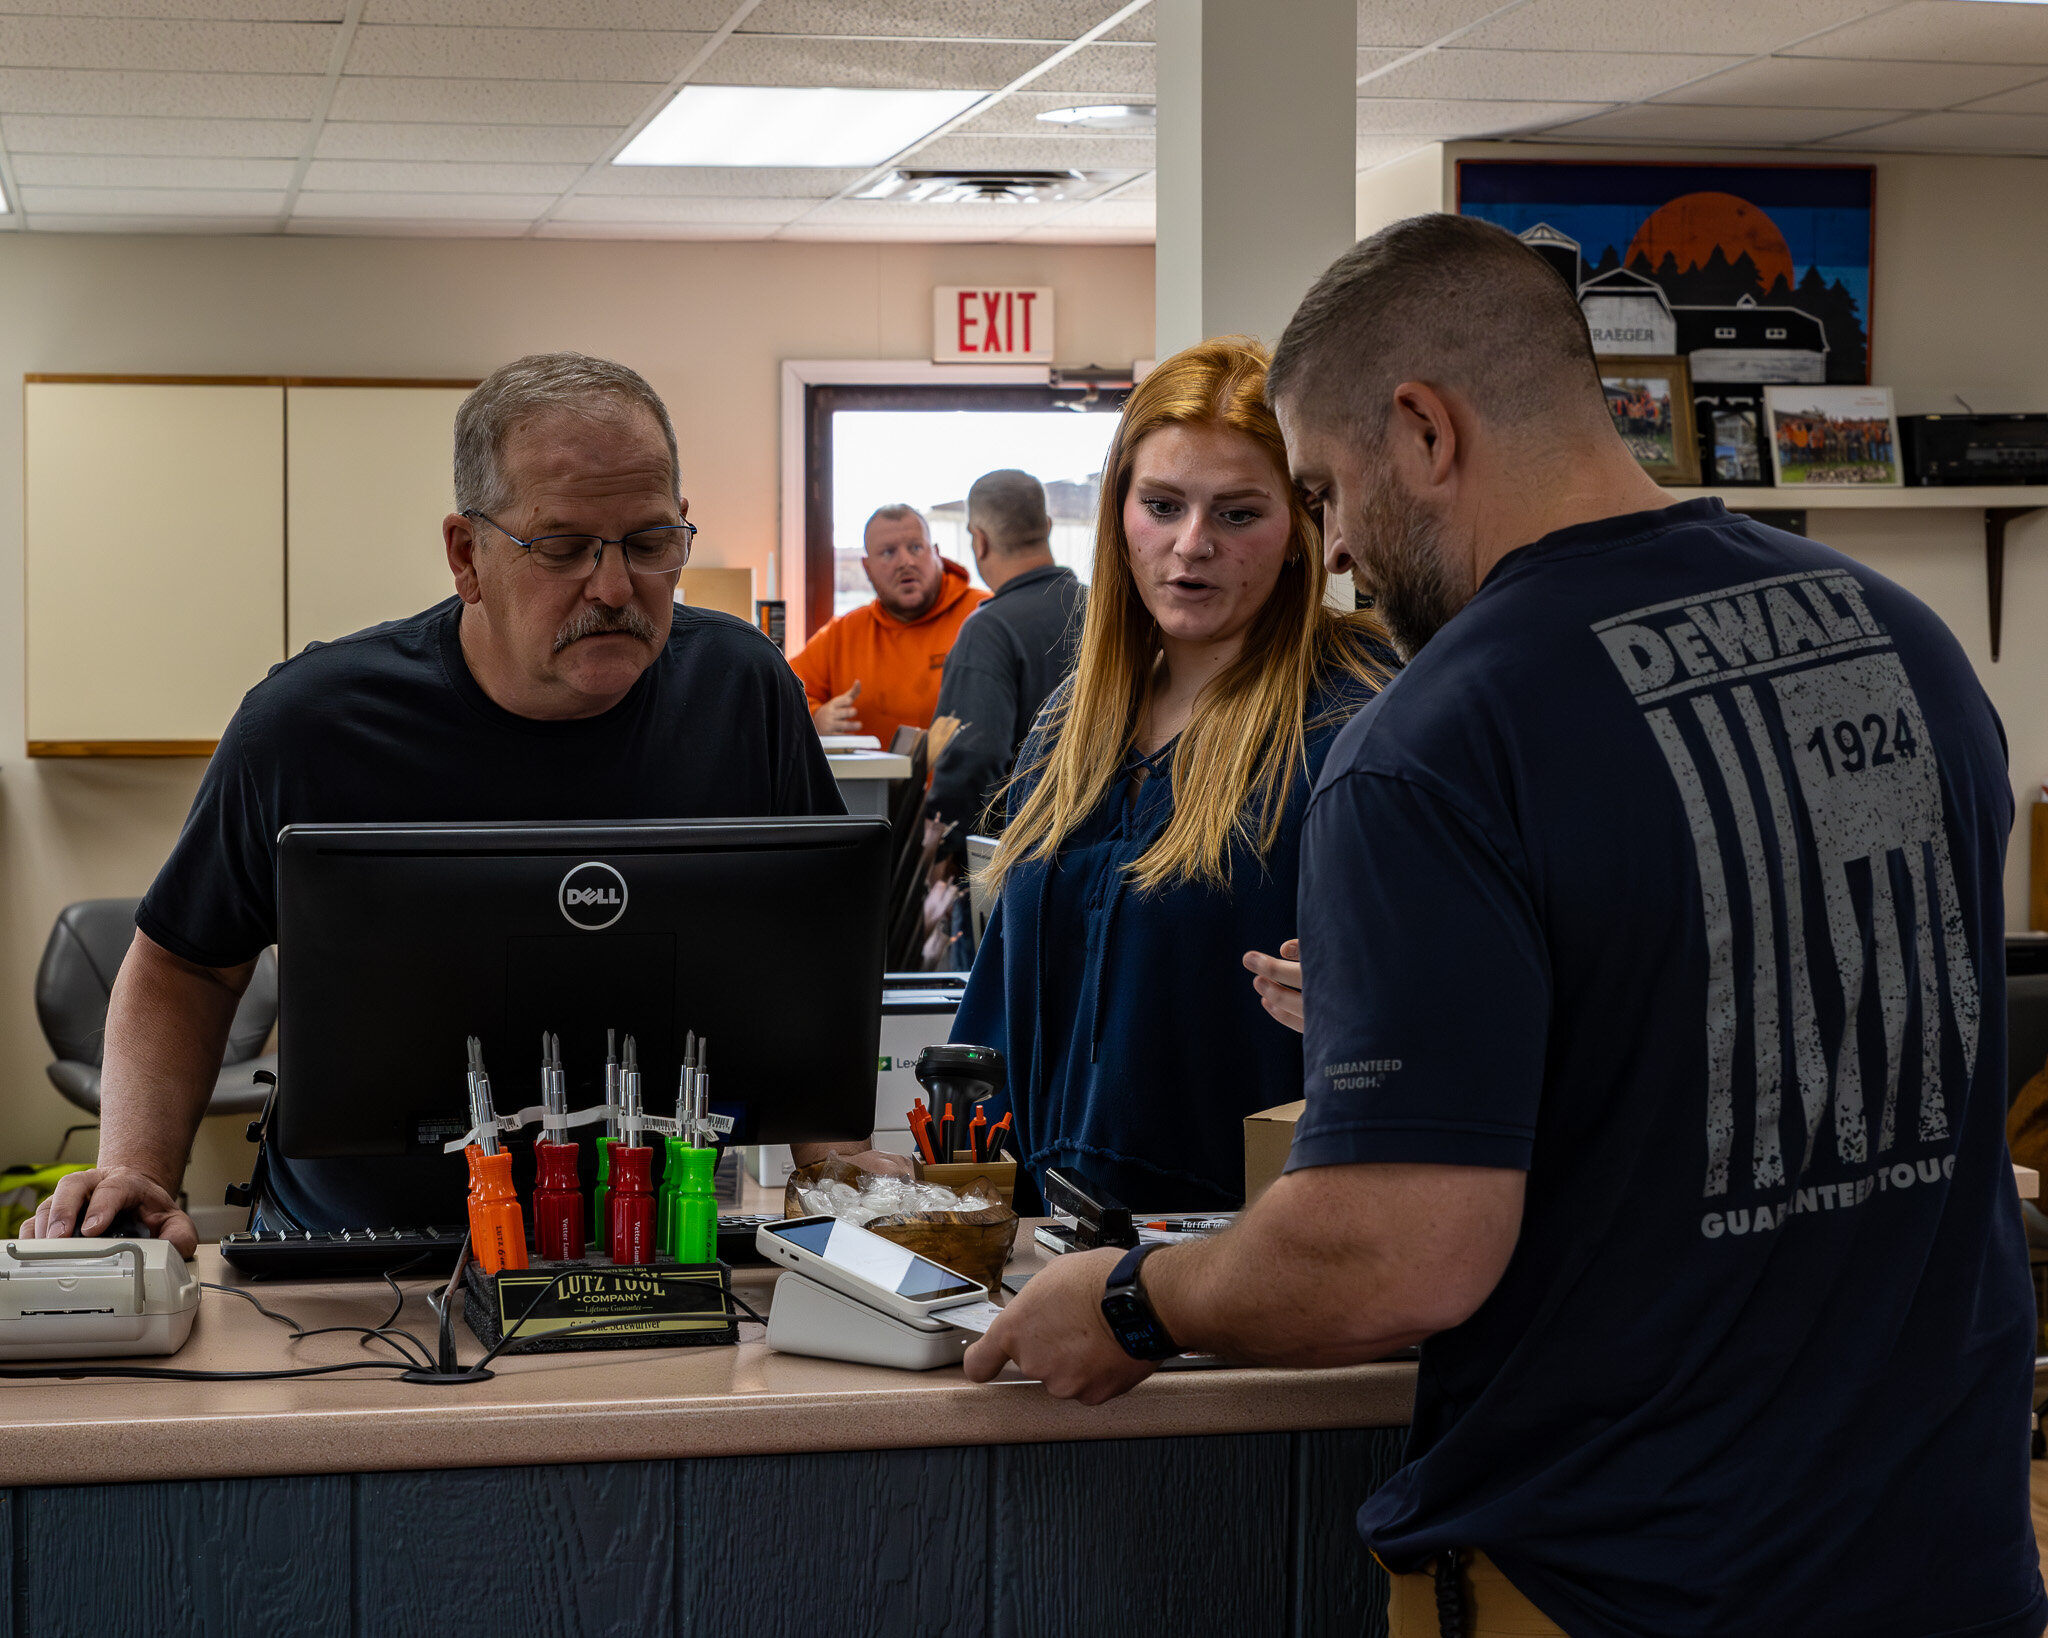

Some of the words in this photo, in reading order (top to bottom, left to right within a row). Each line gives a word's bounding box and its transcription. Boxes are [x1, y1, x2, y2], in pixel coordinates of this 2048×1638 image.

[958, 291, 1037, 353] EXIT
[1590, 328, 1655, 341] RAEGER
[1807, 708, 1917, 778] 1924
[567, 887, 620, 906] DELL
[557, 1275, 605, 1300] LUTZ
[582, 1293, 641, 1303] COMPANY
